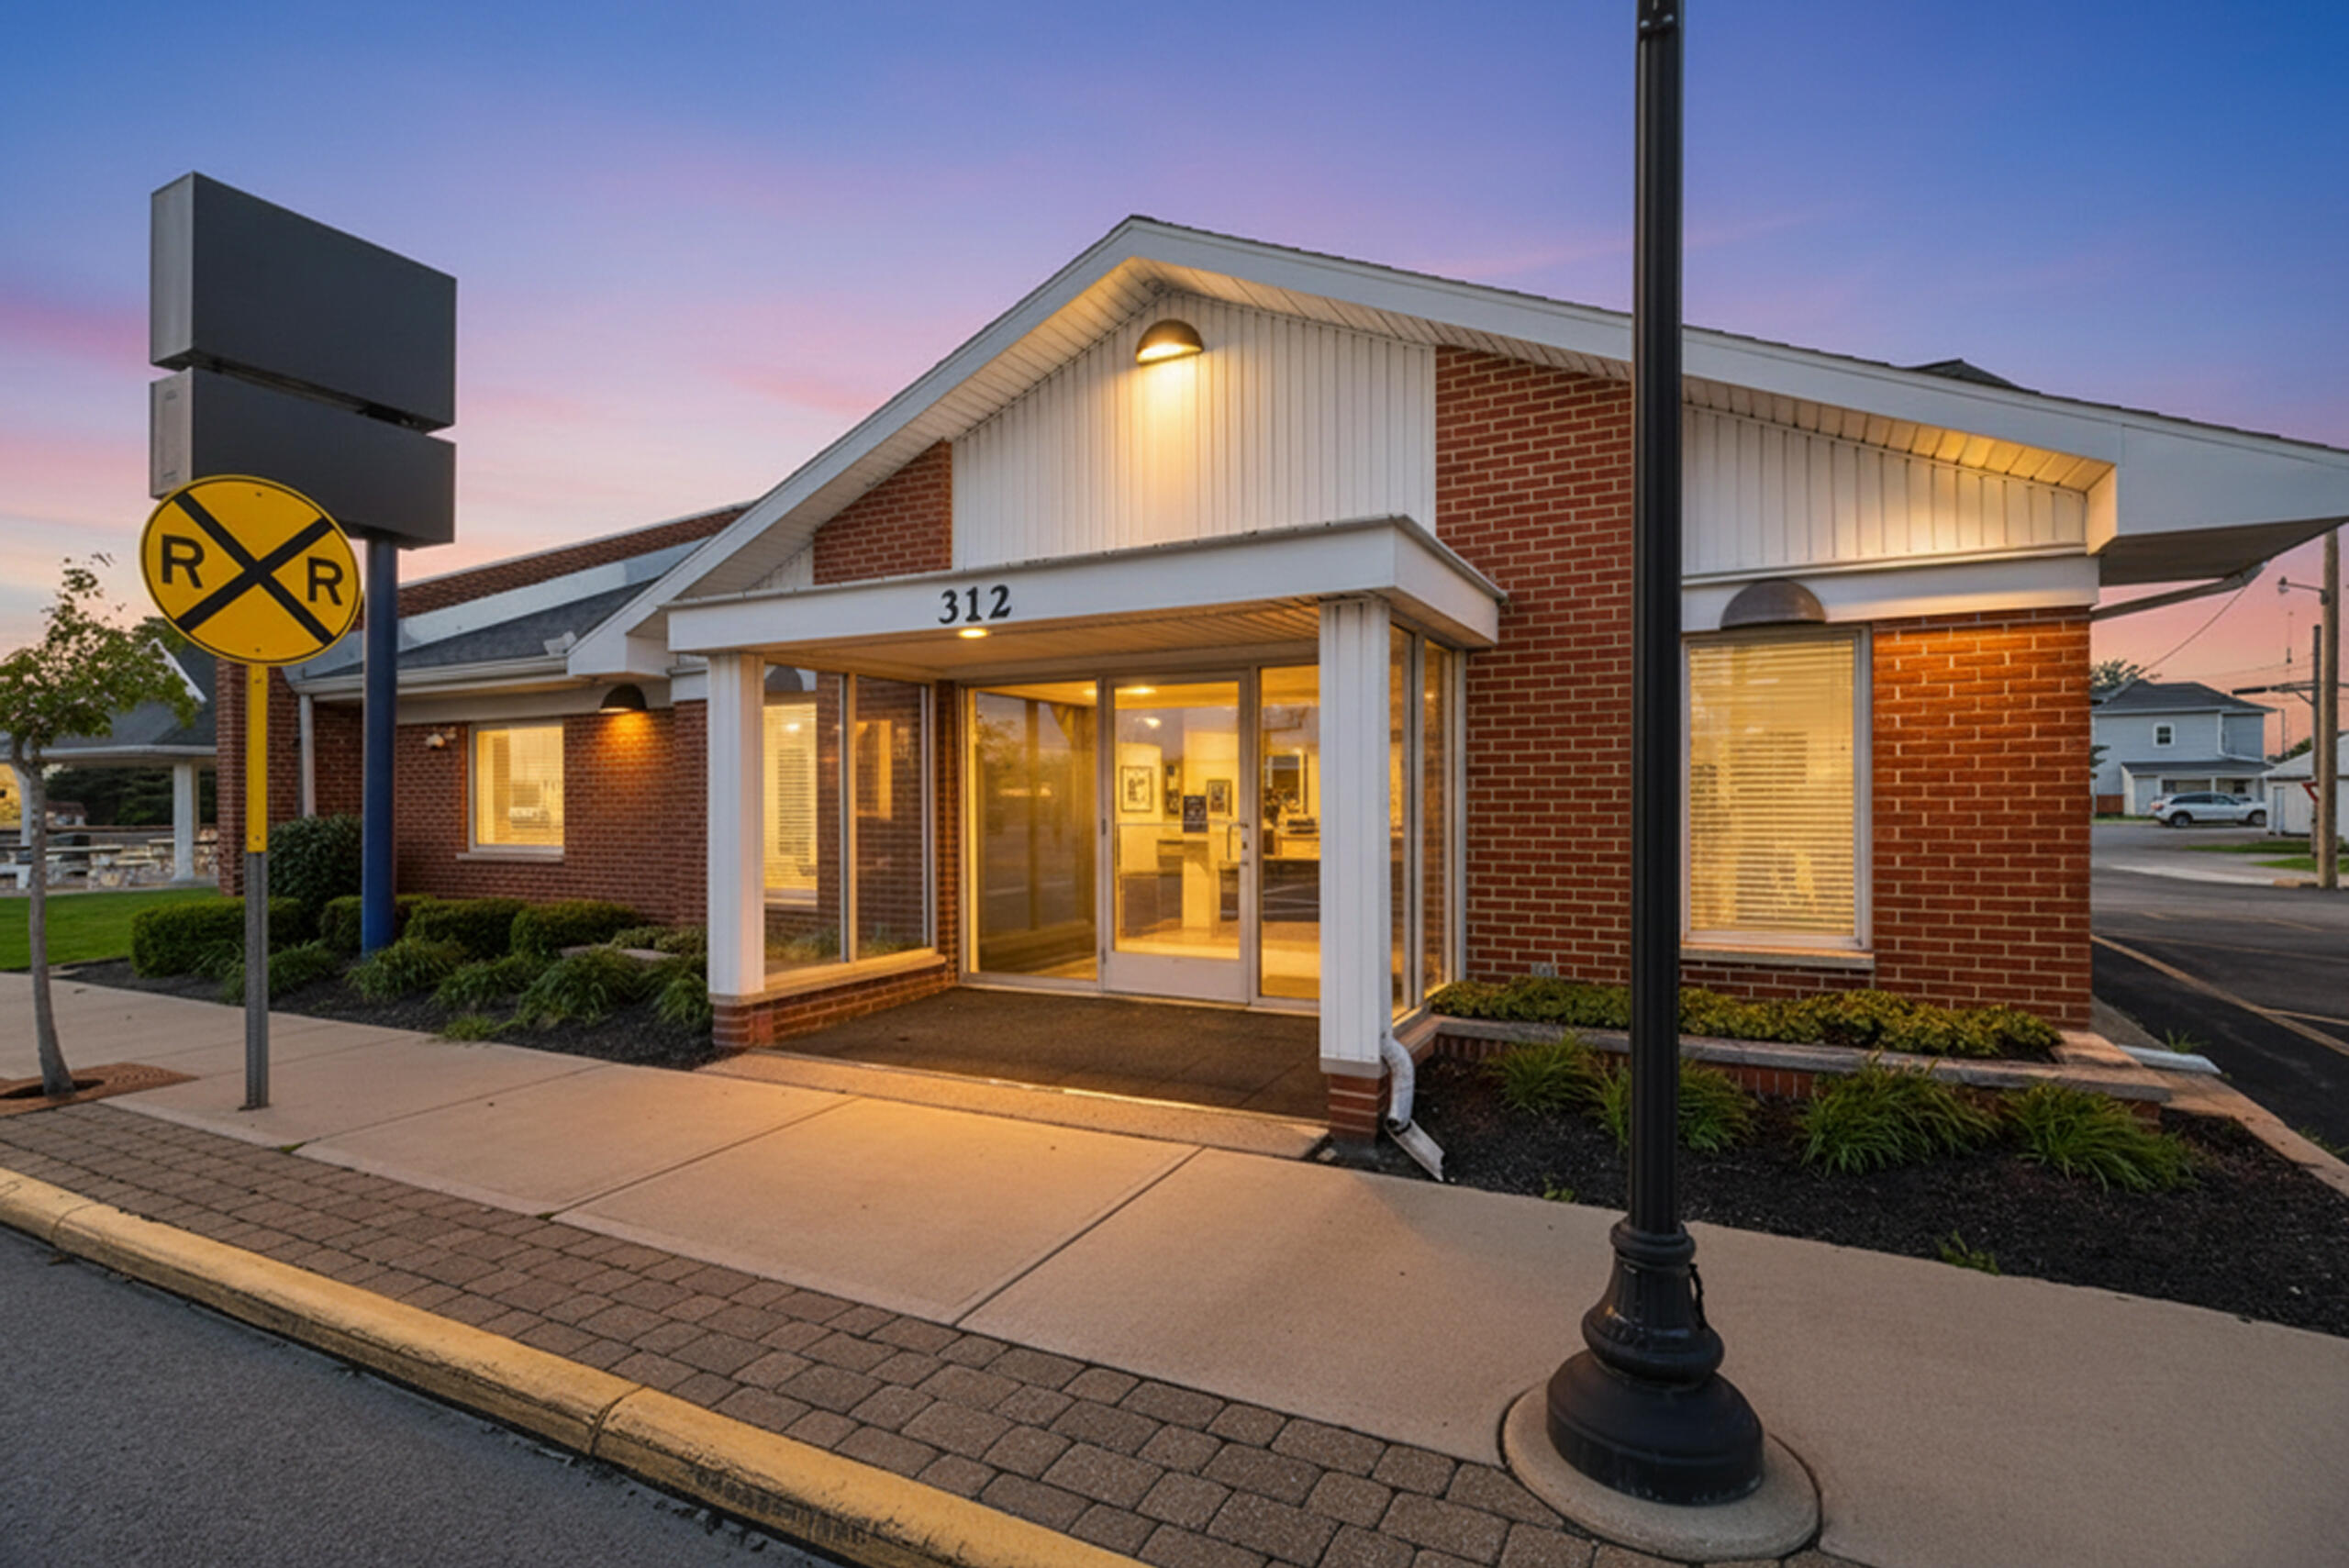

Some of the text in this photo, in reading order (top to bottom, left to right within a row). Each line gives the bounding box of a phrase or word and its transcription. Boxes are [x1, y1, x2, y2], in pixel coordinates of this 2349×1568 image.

[161, 534, 343, 606] R R
[938, 584, 1012, 625] 312
